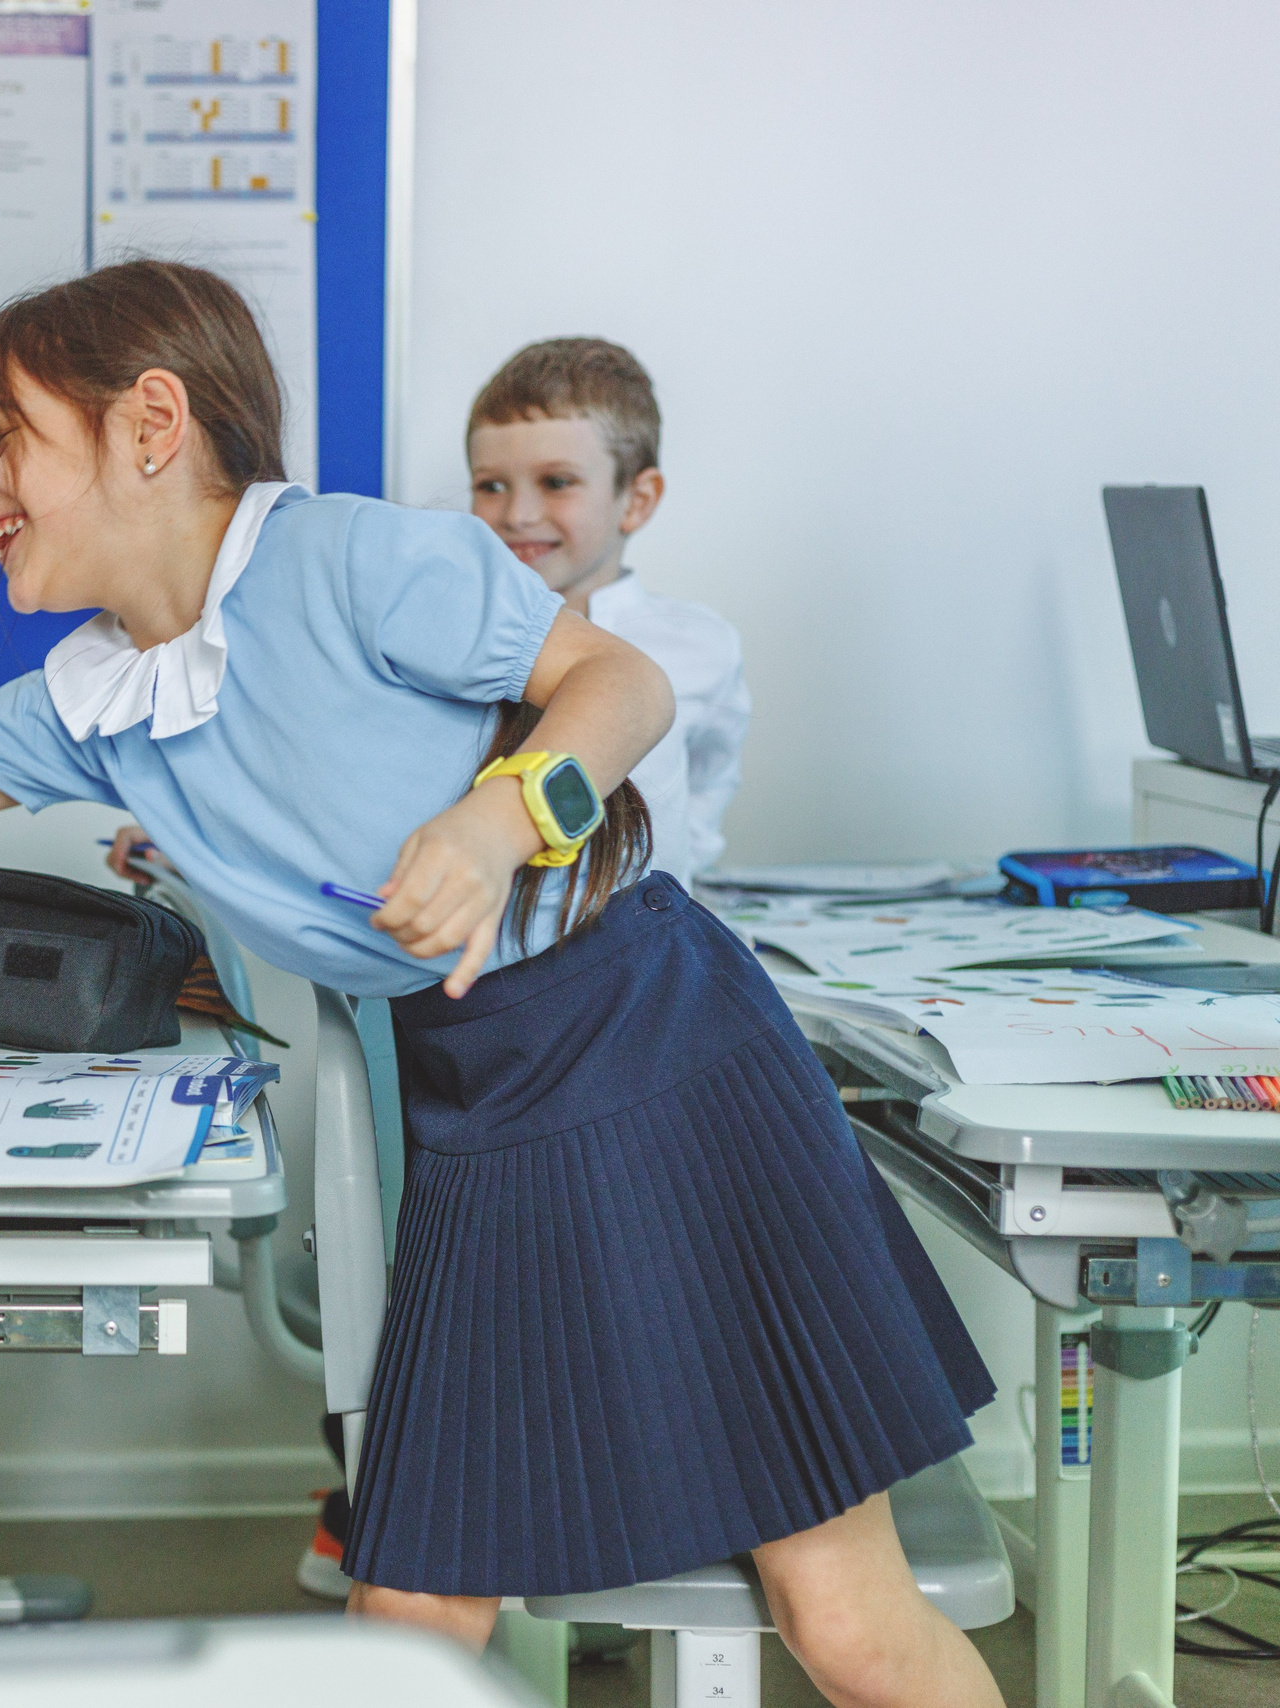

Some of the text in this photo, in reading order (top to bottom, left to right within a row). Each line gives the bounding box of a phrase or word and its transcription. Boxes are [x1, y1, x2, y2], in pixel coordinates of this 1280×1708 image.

[1006, 1022, 1279, 1057] This
[712, 1653, 725, 1663] 32
[712, 1686, 724, 1696] 34
